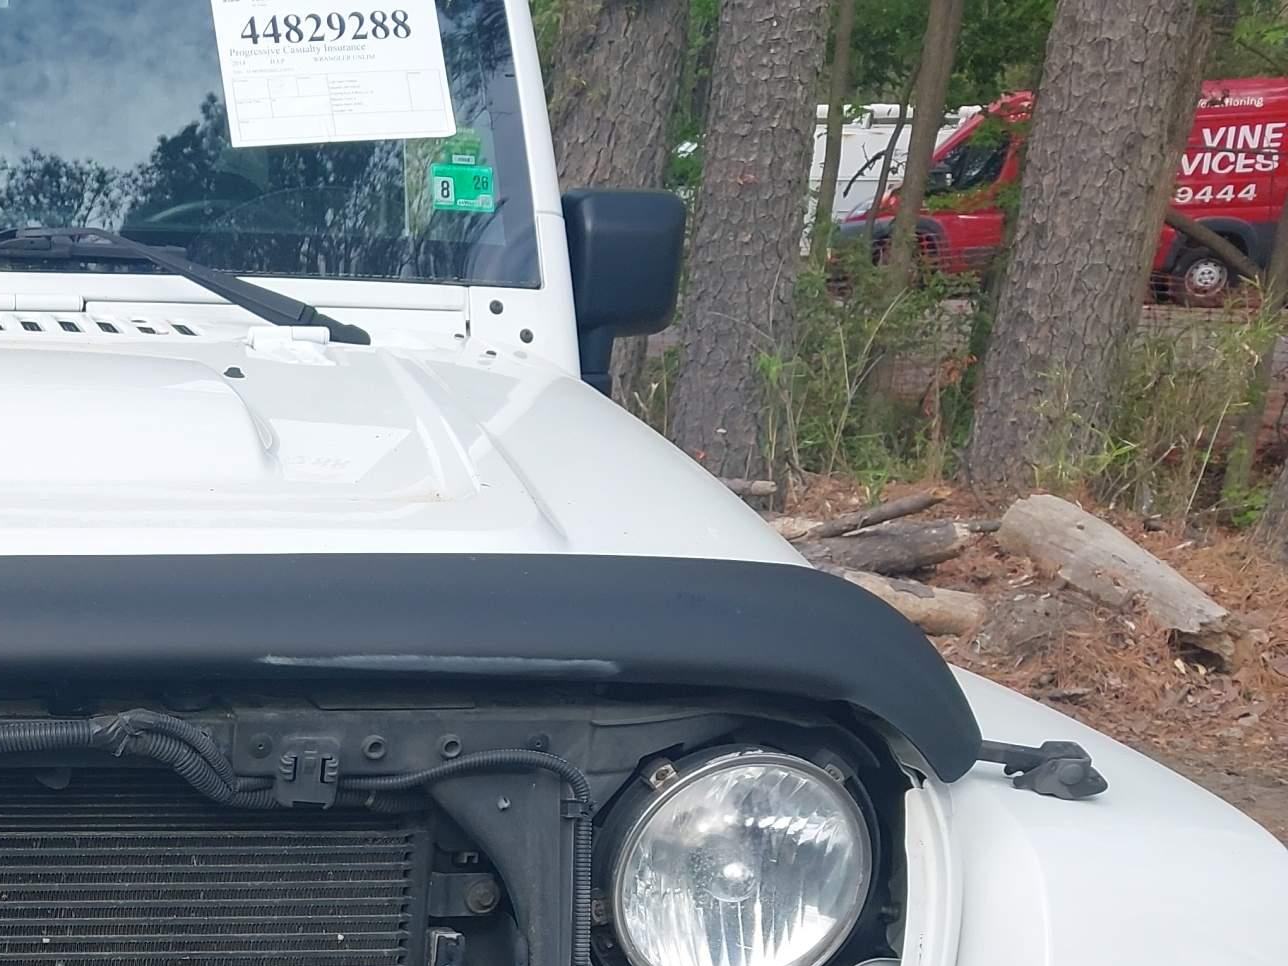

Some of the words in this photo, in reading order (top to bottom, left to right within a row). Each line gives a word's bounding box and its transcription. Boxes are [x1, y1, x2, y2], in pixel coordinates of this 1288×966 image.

[240, 9, 412, 45] 44829288
[229, 47, 280, 57] Progressive
[283, 44, 321, 54] Casualty
[324, 43, 366, 52] Insurance
[1202, 123, 1286, 149] VINE
[1178, 149, 1279, 175] VICES
[440, 180, 450, 198] 8
[473, 175, 489, 191] 26
[1175, 184, 1257, 203] 9444
